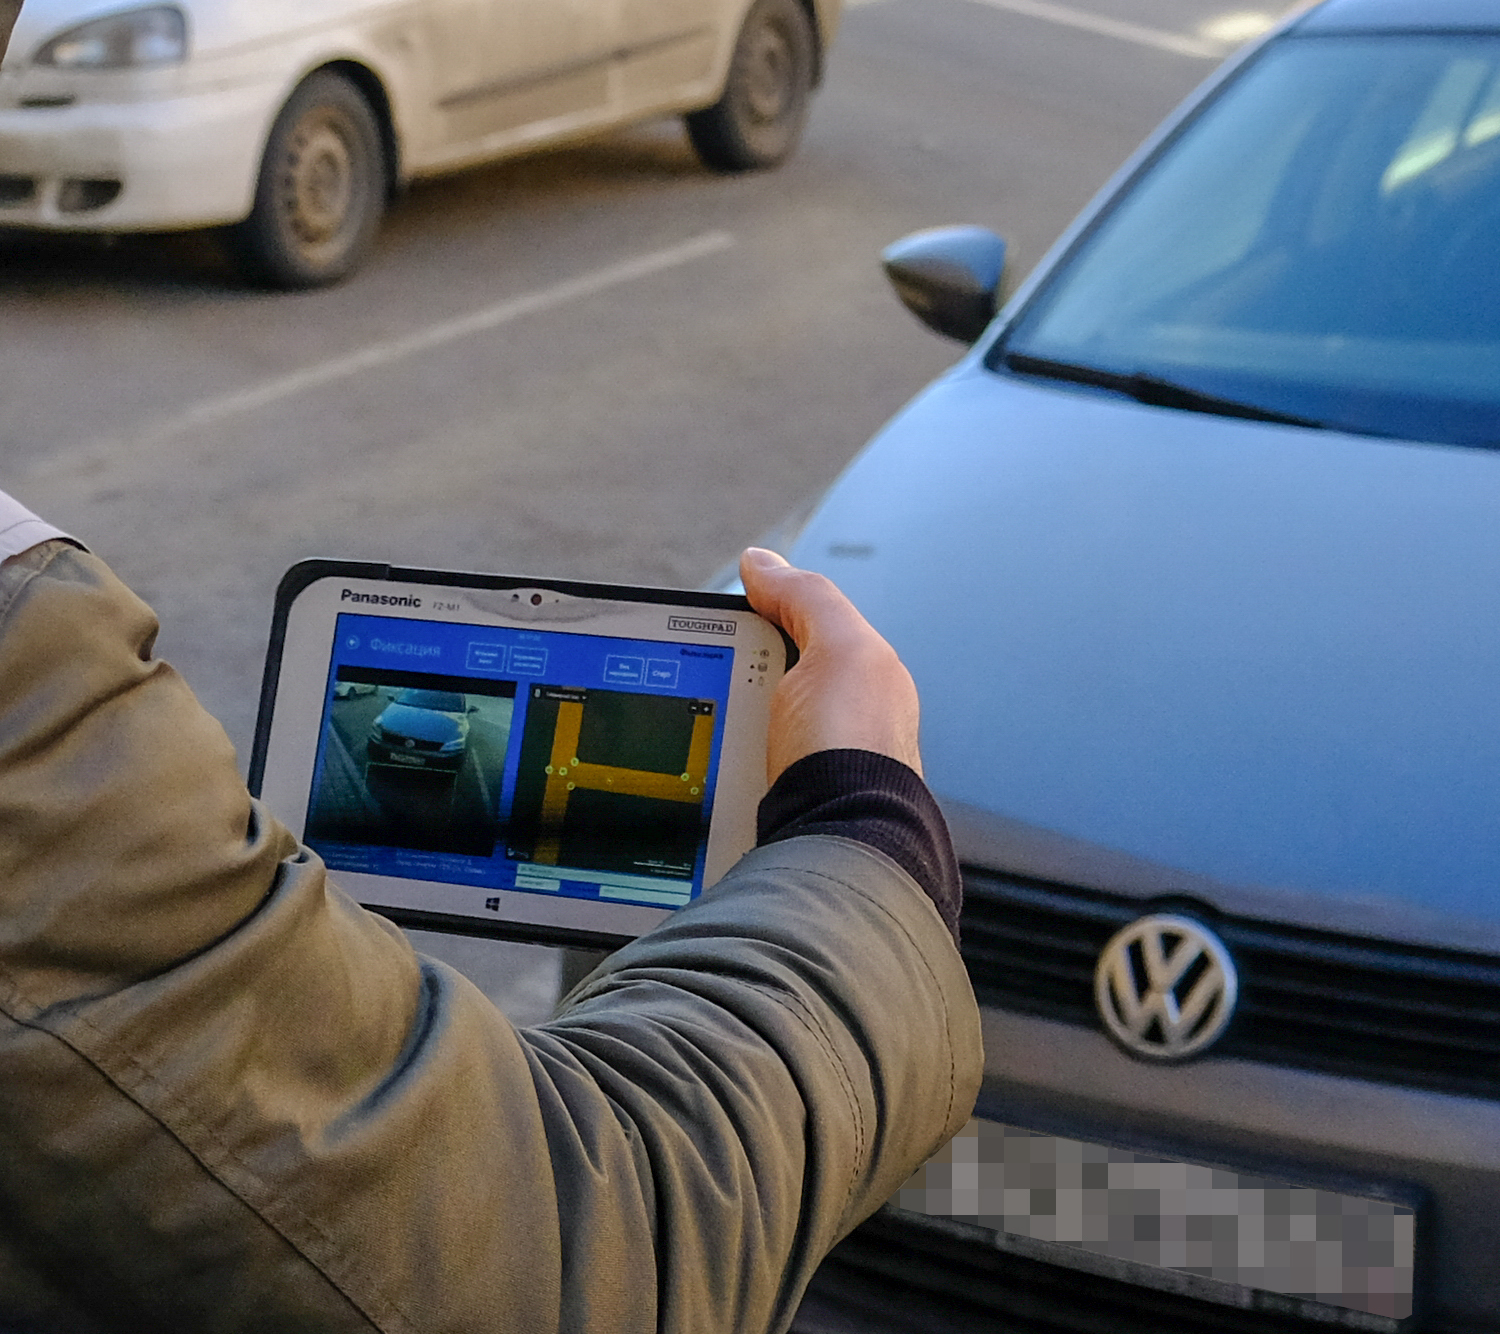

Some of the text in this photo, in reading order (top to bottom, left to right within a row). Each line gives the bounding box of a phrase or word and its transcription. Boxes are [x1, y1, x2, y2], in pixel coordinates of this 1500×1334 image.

[341, 588, 422, 608] Panasonic
[671, 619, 734, 633] TOUGHPAD
[370, 637, 441, 658] Фиксация
